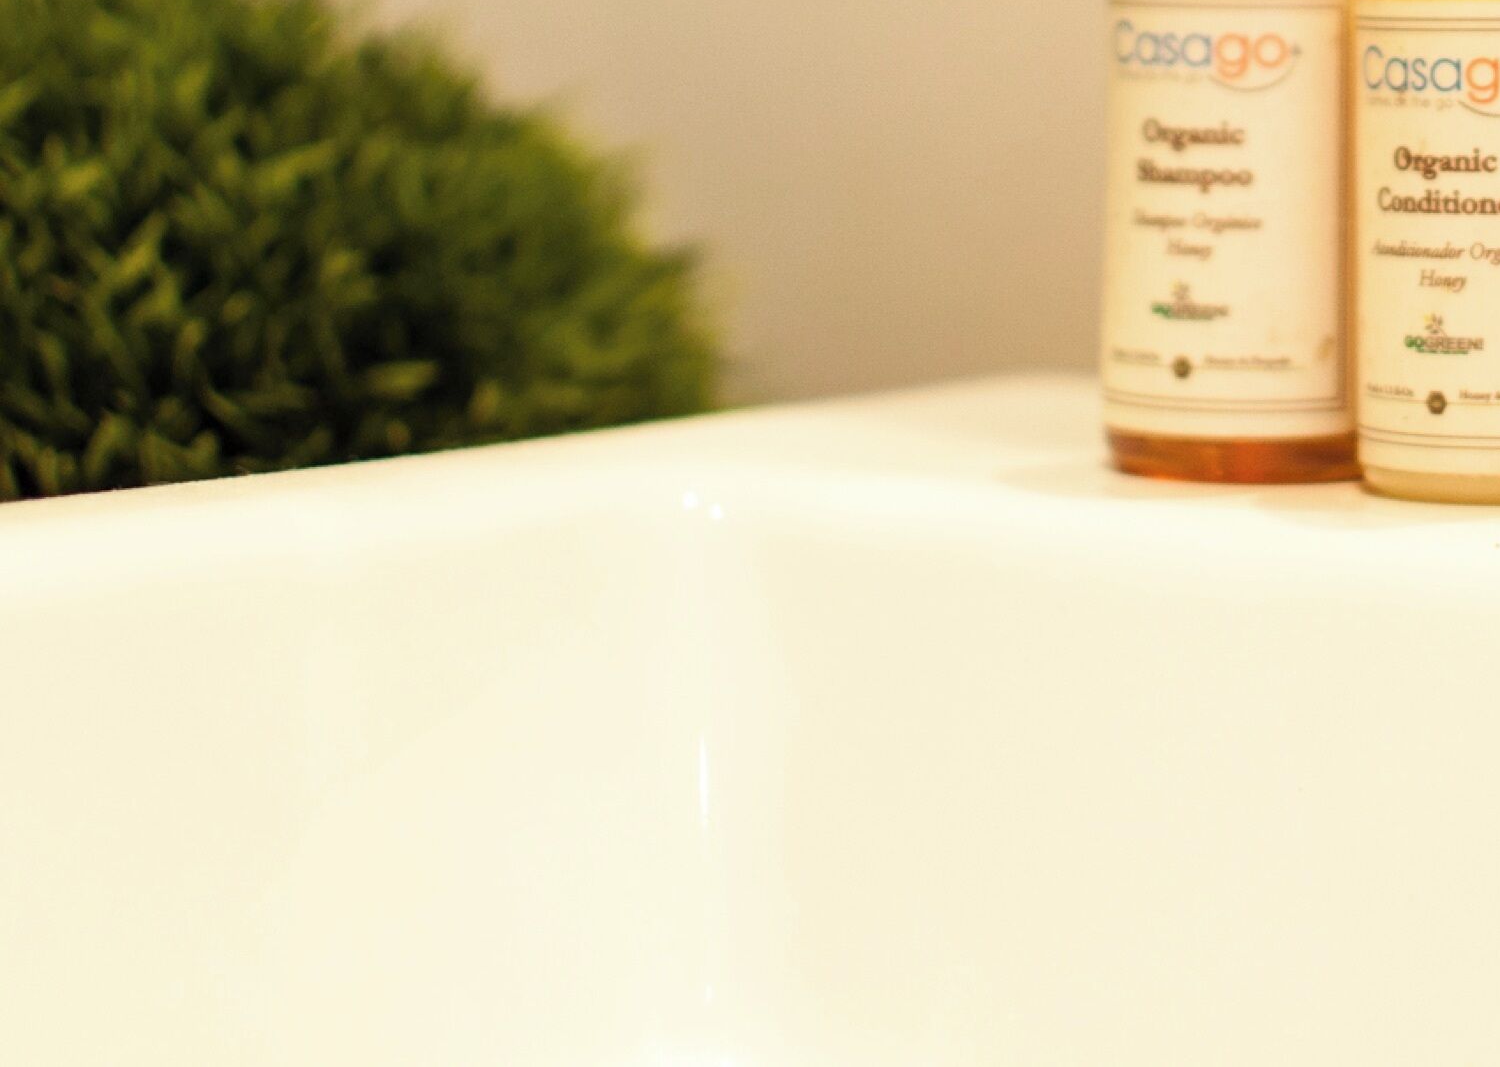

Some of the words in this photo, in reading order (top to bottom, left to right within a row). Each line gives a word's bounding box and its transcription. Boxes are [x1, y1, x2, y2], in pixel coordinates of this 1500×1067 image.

[1114, 18, 1291, 80] Casago
[1393, 146, 1497, 180] Organic
[1419, 269, 1468, 293] Honey
